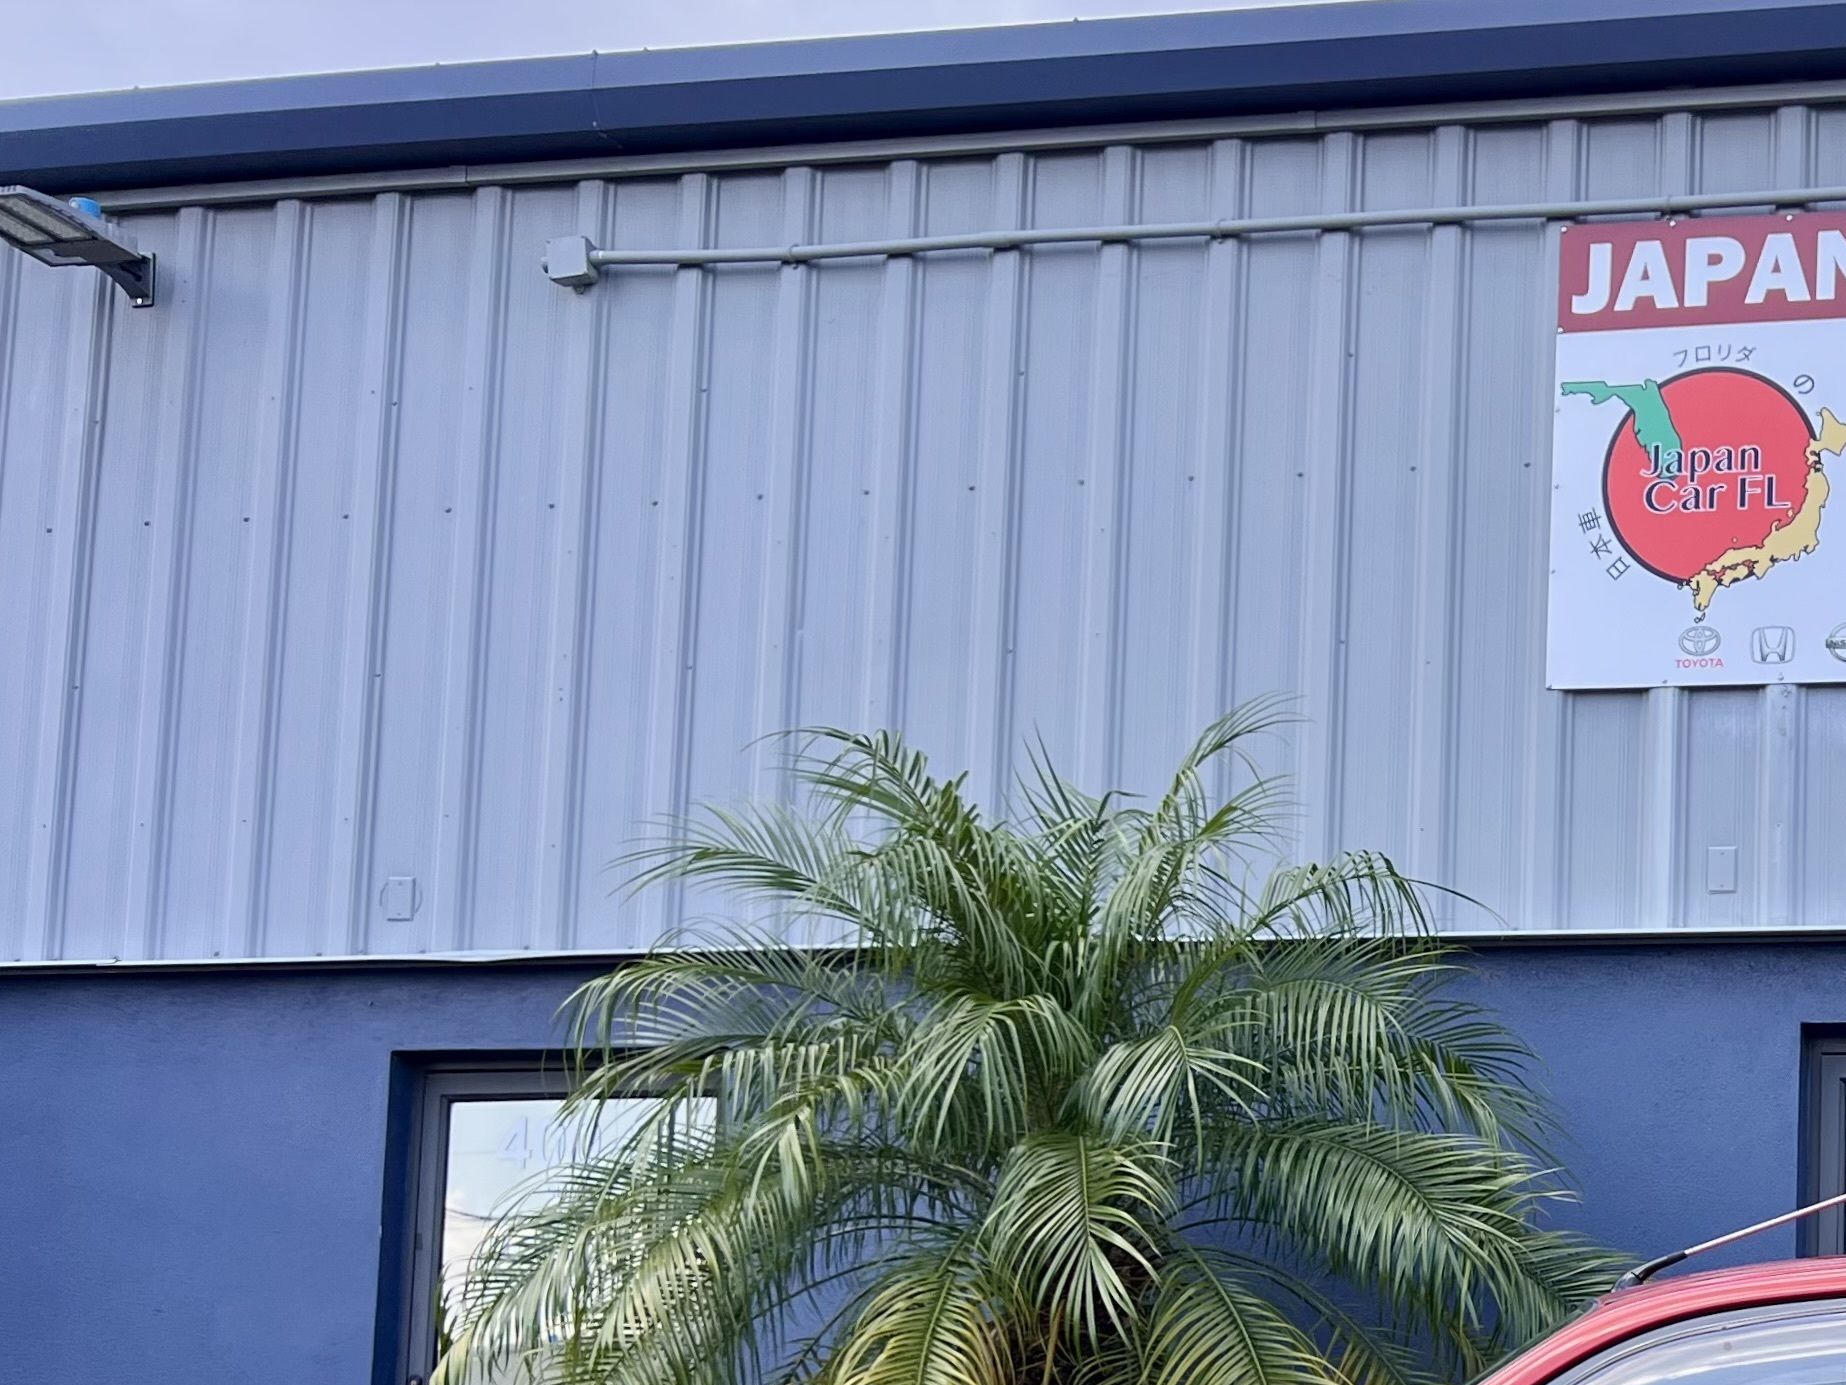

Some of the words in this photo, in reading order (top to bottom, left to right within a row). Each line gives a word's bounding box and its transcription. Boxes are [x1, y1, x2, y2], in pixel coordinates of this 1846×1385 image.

[1673, 344, 1757, 368] フロリダ
[1793, 374, 1815, 394] の
[1641, 444, 1762, 483] Japan
[1645, 478, 1725, 514] Car
[1737, 475, 1791, 509] FL
[1675, 658, 1724, 669] TOYOTA
